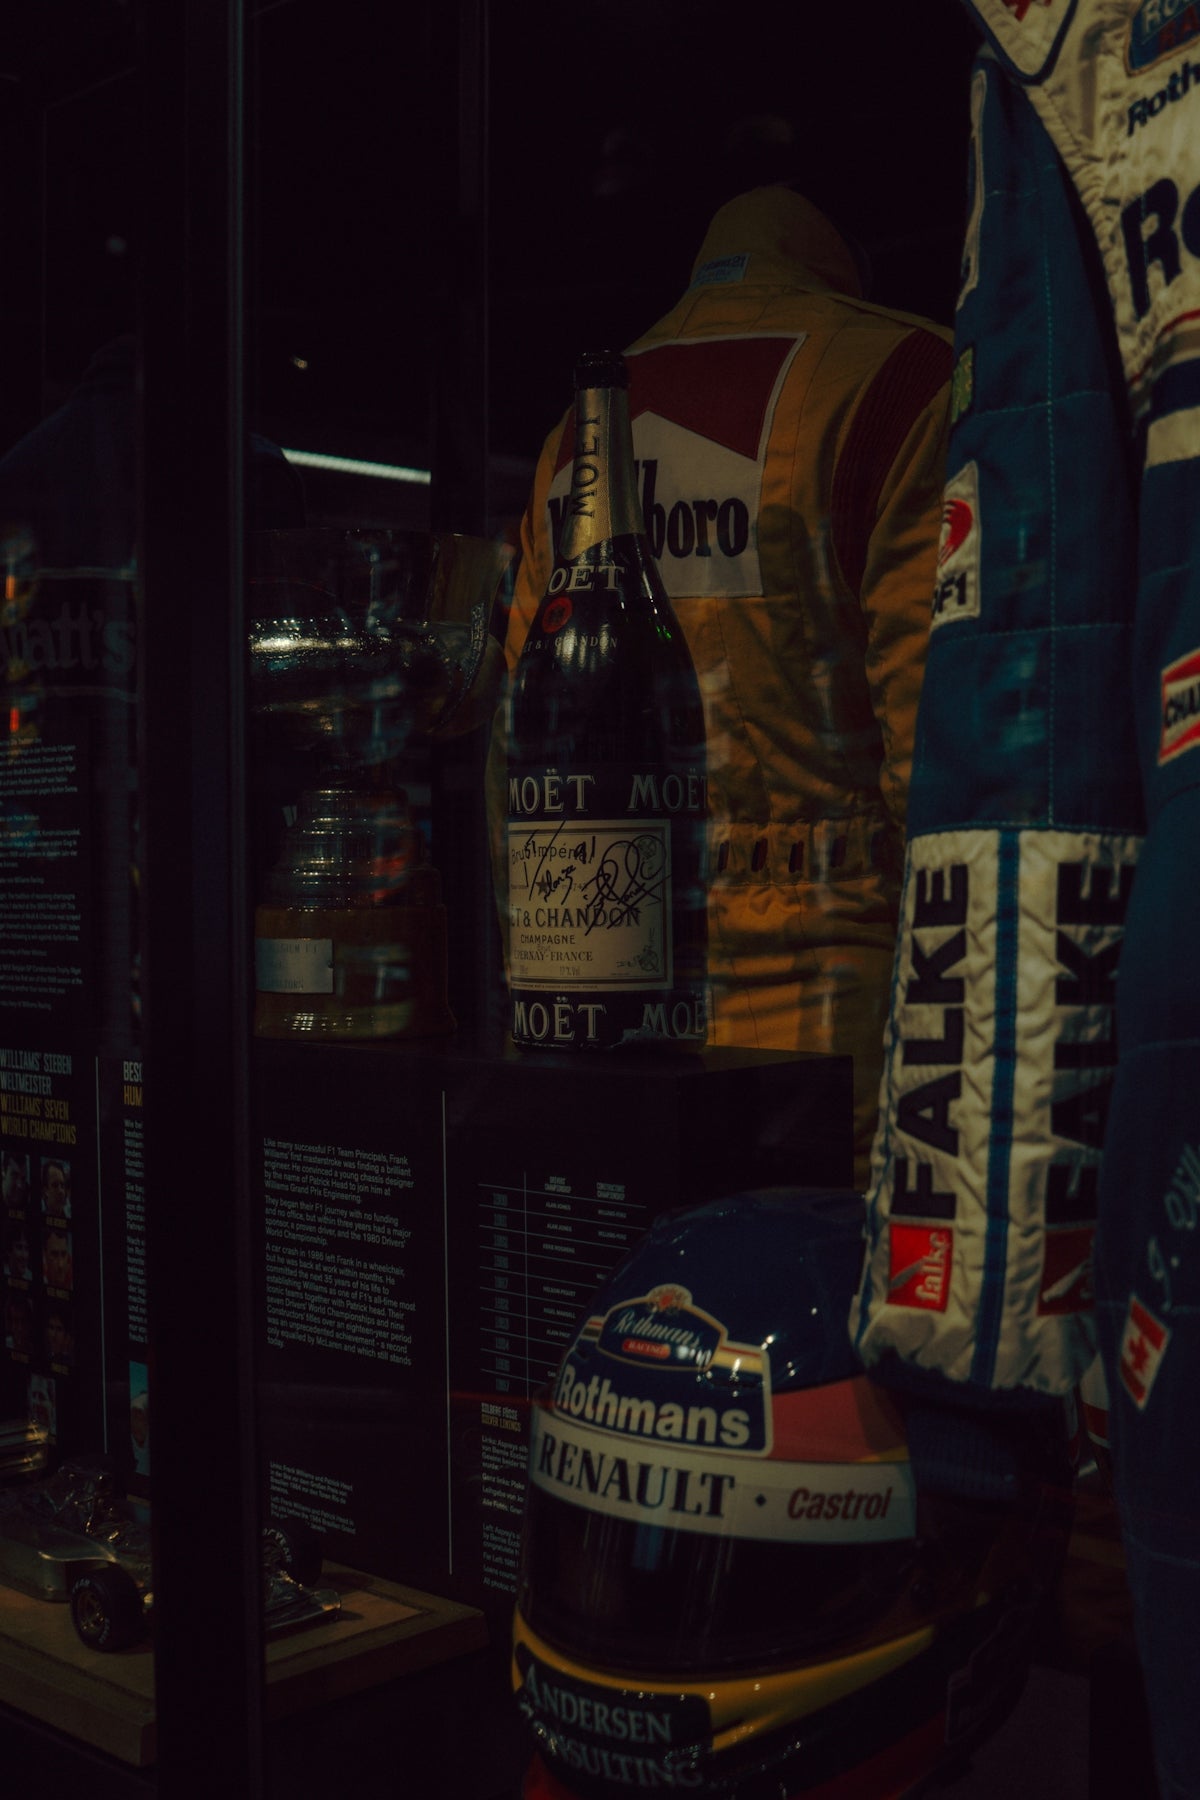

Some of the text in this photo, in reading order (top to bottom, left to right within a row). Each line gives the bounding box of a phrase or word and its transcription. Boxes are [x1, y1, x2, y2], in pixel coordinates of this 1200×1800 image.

[521, 934, 576, 945] CHAMPAGNE
[535, 907, 641, 928] CHANDON
[891, 864, 968, 1219] FALKE
[30, 1119, 77, 1145] CHAMPIONS
[557, 1364, 750, 1447] Rothmans
[539, 1432, 735, 1519] RENAULT
[788, 1487, 894, 1521] Castrol
[526, 1664, 673, 1743] ANDERSEN
